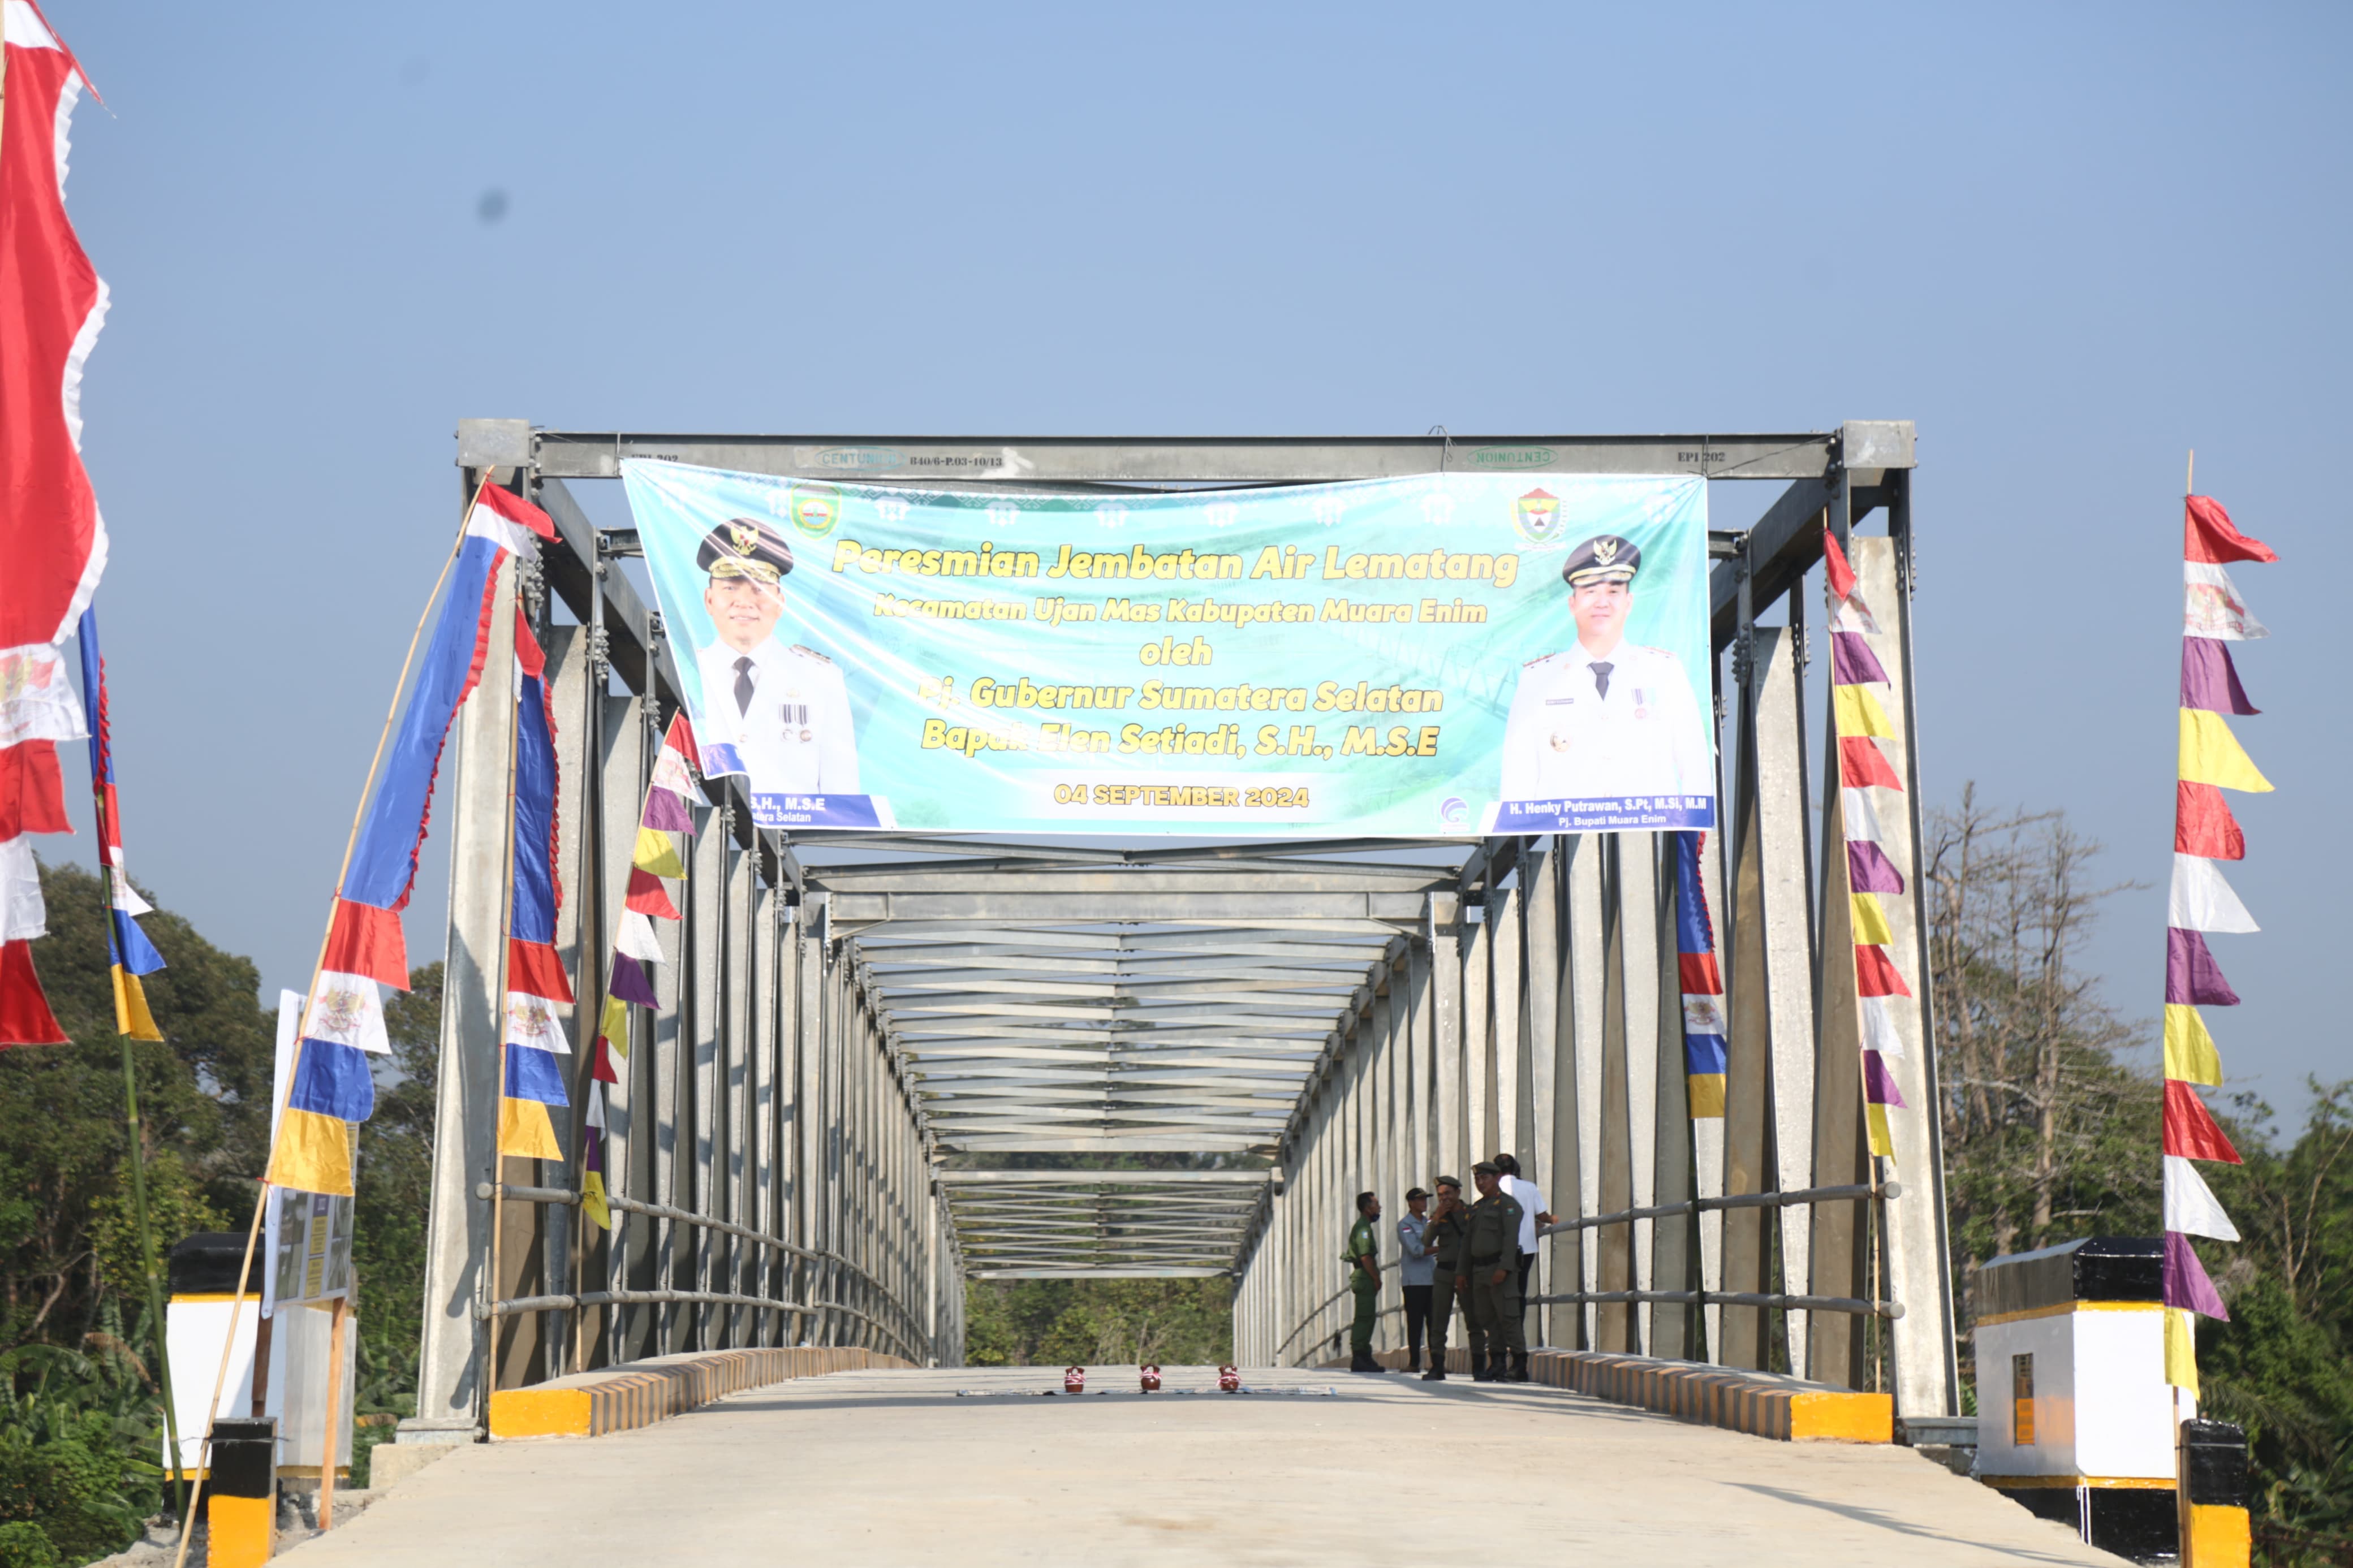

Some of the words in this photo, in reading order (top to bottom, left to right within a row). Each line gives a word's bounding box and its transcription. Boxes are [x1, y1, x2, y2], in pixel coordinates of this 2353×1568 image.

[1476, 452, 1550, 463] CENTUNION
[1678, 452, 1699, 462] EPI
[1703, 452, 1725, 462] 202
[831, 539, 1040, 578] Peresmian
[1046, 544, 1243, 580] Jembatan
[1249, 545, 1316, 580] Air
[1322, 546, 1519, 588] Lematang
[873, 593, 1027, 620] Kecamatan
[1034, 597, 1096, 627] Ujan
[1101, 598, 1161, 622] Mas
[1166, 598, 1315, 628] Kabupaten
[1319, 598, 1413, 623] Muara
[1418, 598, 1488, 623] Enim
[1139, 636, 1212, 666] oleh
[917, 675, 960, 711] Pj.
[969, 677, 1135, 709] Gubernur
[1137, 679, 1308, 711] Sumatera
[1312, 681, 1443, 713] Selatan
[921, 719, 1029, 758] Bapak
[1037, 723, 1111, 753] Elen
[1118, 723, 1247, 759] Setiadi,
[1254, 724, 1333, 761] S.H.,
[1339, 725, 1440, 757] M.S.E
[785, 797, 826, 811] M.S.E
[1054, 784, 1088, 805] 04
[1093, 785, 1240, 807] SEPTEMBER
[1244, 787, 1309, 808] 2024
[1510, 802, 1523, 815] H.
[1525, 801, 1561, 816] Henky
[1563, 800, 1622, 813] Putrawan,
[1624, 798, 1652, 812] S.Pt,
[1654, 797, 1683, 811] M.Si,
[1685, 797, 1706, 810] M.M
[776, 811, 812, 823] Selatan
[1558, 817, 1572, 828] Pj.
[1574, 816, 1606, 827] Bupati
[1608, 815, 1639, 825] Muara
[1641, 814, 1667, 824] Enim
